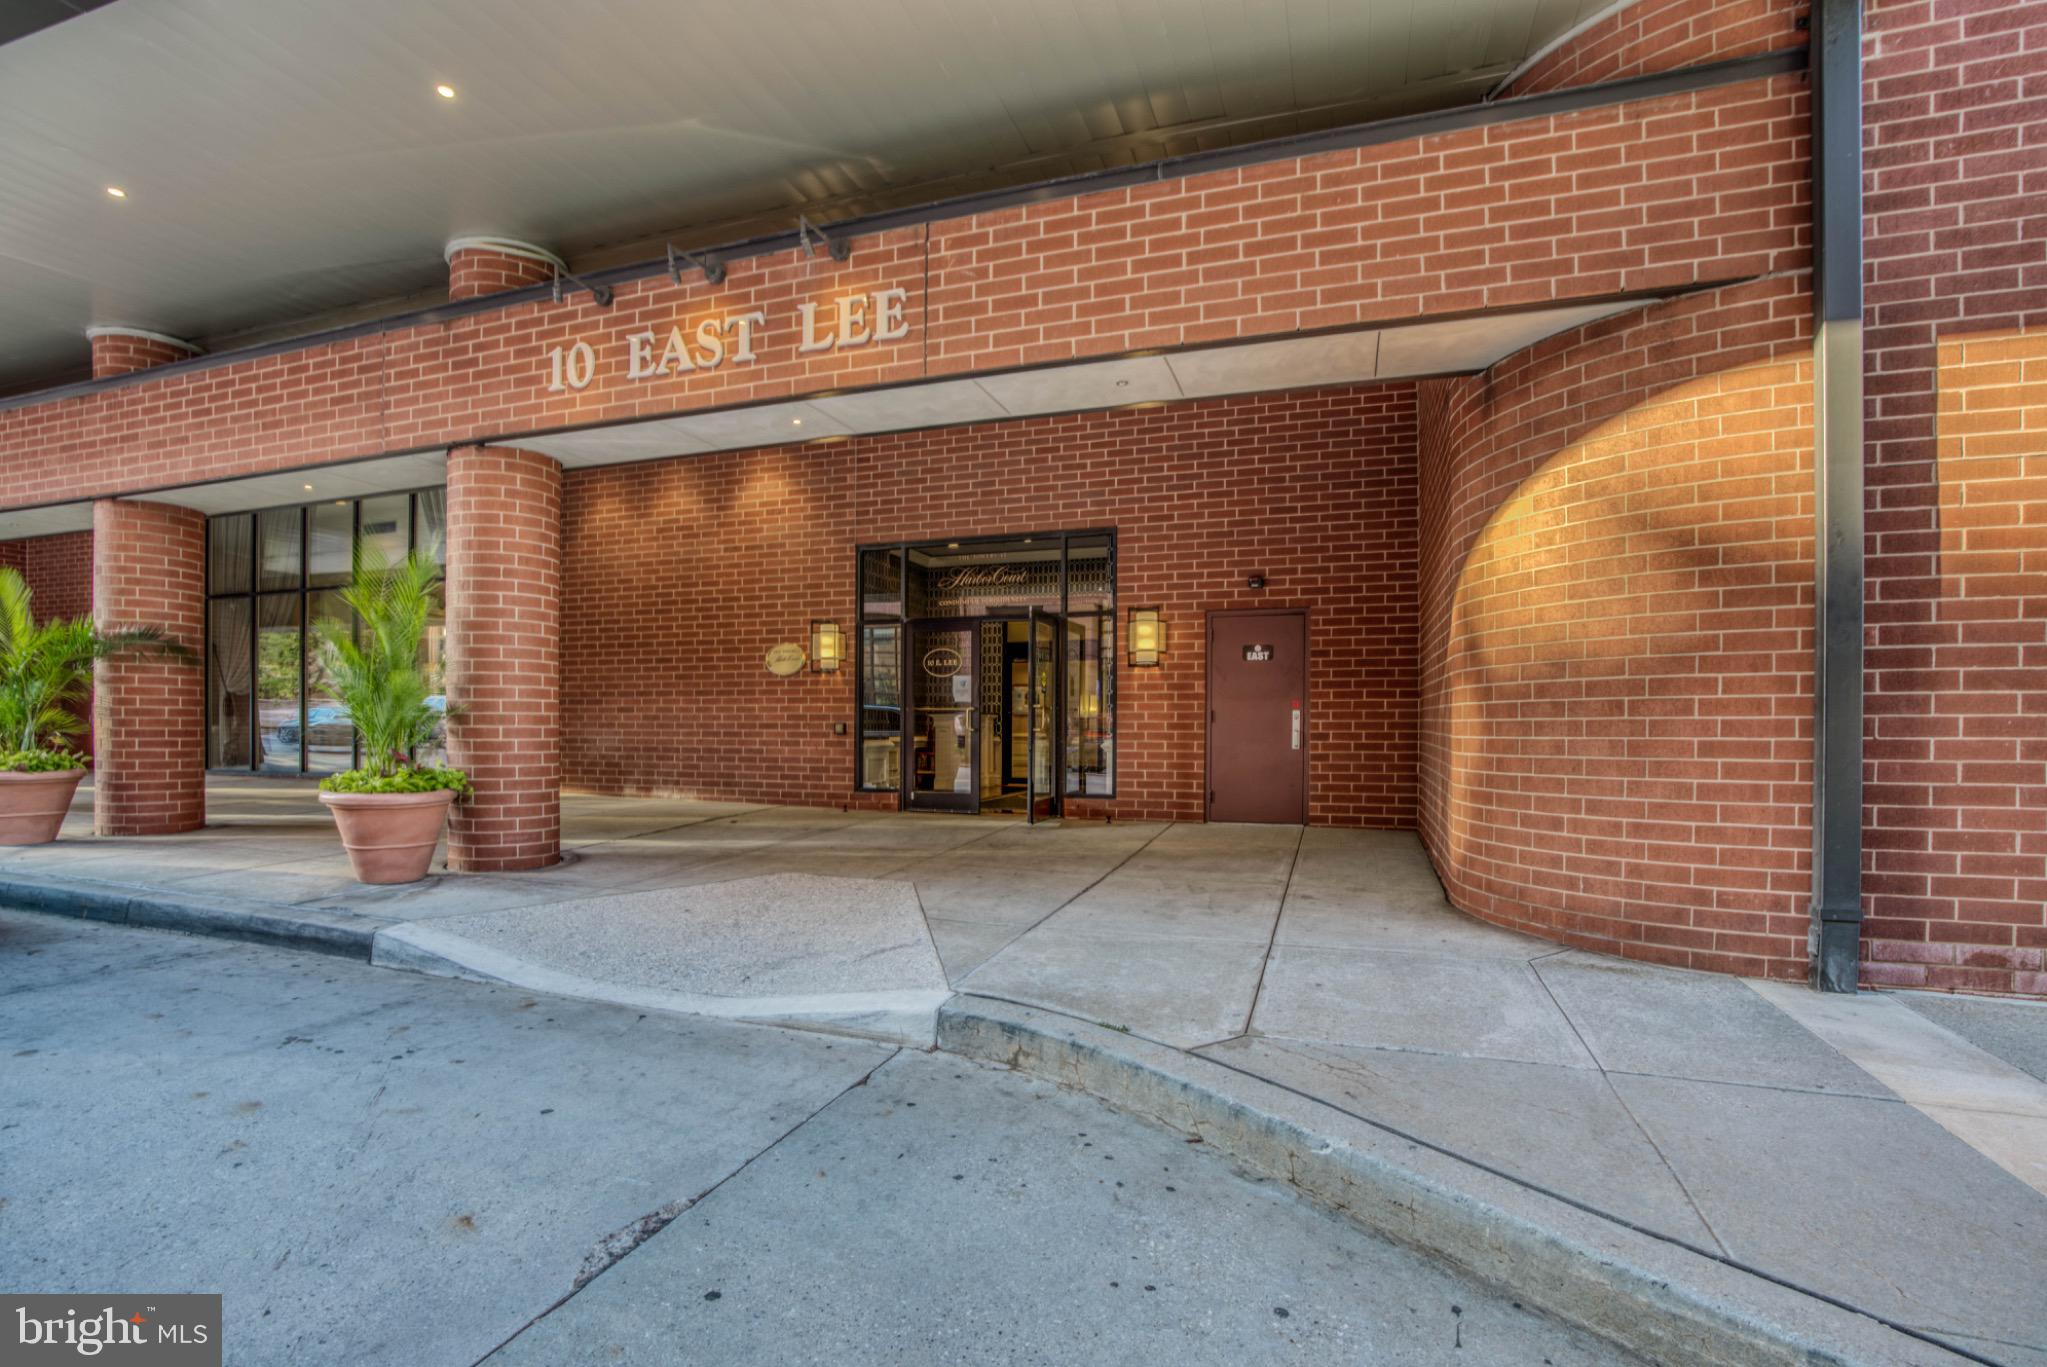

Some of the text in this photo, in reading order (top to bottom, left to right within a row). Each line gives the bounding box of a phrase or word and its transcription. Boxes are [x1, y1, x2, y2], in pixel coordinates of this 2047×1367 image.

[547, 287, 911, 393] 10 EAST LEE
[937, 567, 992, 590] Harbor
[1246, 651, 1270, 661] EAST
